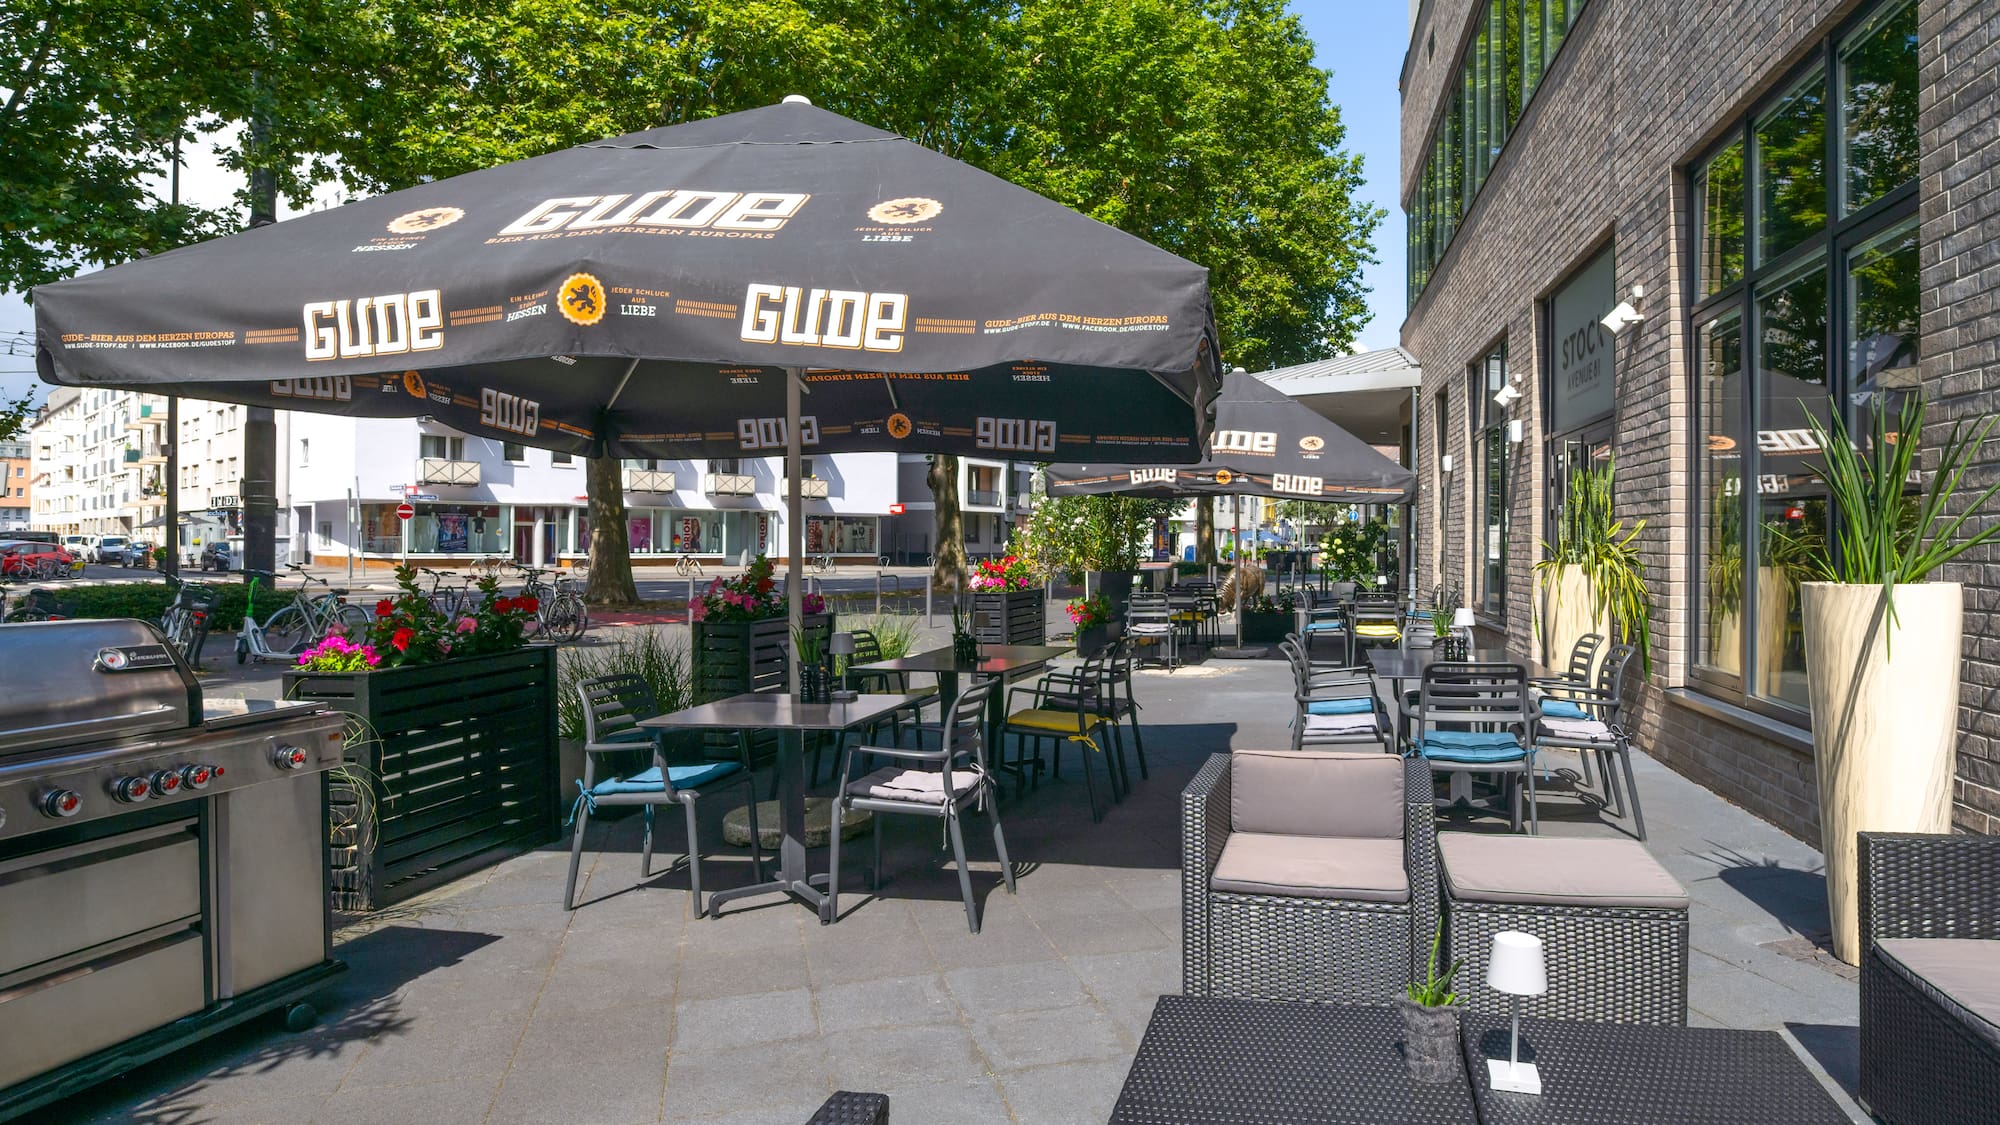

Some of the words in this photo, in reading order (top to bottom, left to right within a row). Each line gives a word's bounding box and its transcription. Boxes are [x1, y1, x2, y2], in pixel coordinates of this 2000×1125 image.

[483, 236, 525, 245] BIER
[527, 233, 563, 242] AUS
[608, 226, 685, 236] HERZEN
[687, 230, 776, 240] EUROPAS
[635, 288, 671, 298] SCHLUCK
[506, 303, 548, 323] HESSEN
[620, 304, 657, 317] LIEBE
[1037, 313, 1058, 321] AUS
[1059, 314, 1082, 323] DEM
[1082, 316, 1123, 326] HERZEN
[1123, 315, 1168, 325] EUROPAS
[114, 334, 134, 342] AUS
[136, 334, 157, 342] DEM
[158, 332, 193, 341] HERZEN
[194, 331, 235, 340] EUROPAS
